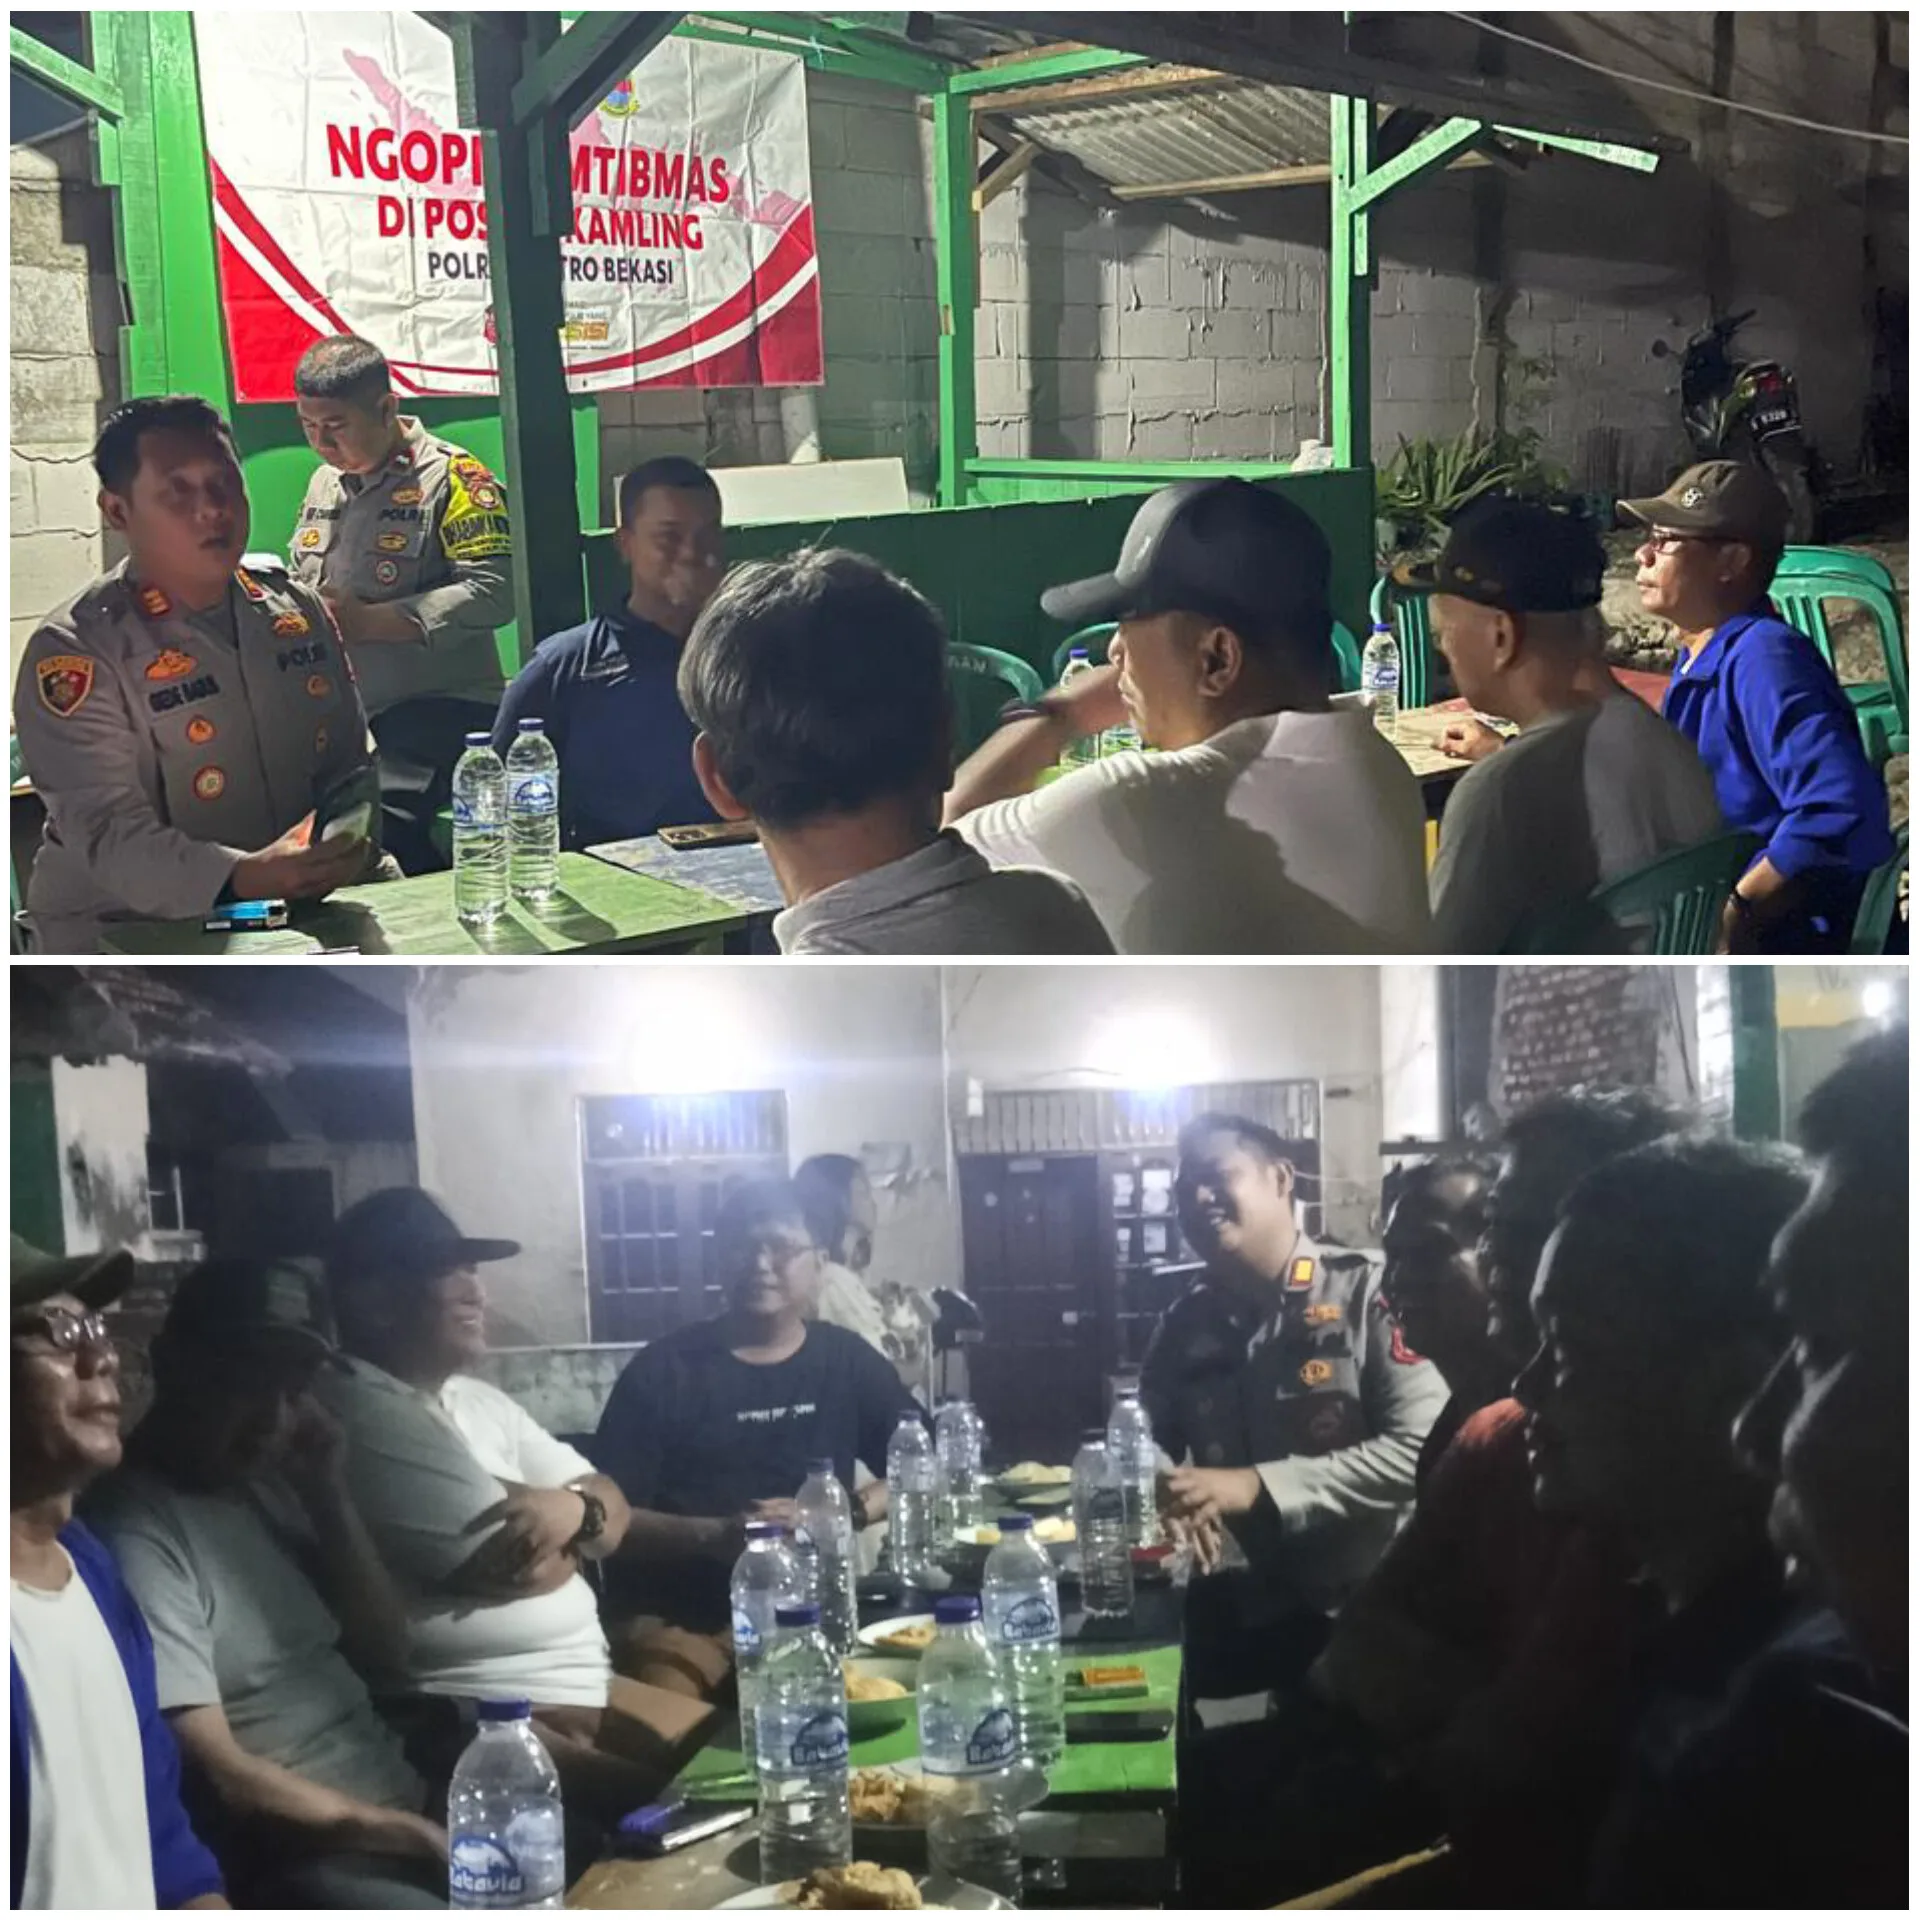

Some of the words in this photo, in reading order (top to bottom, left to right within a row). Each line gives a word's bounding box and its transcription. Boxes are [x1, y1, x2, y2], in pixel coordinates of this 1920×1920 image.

[326, 124, 482, 187] NGOPI
[571, 144, 730, 203] MTIBMAS
[378, 196, 415, 239] DI
[428, 252, 488, 281] POLR
[604, 257, 674, 284] BEKASI
